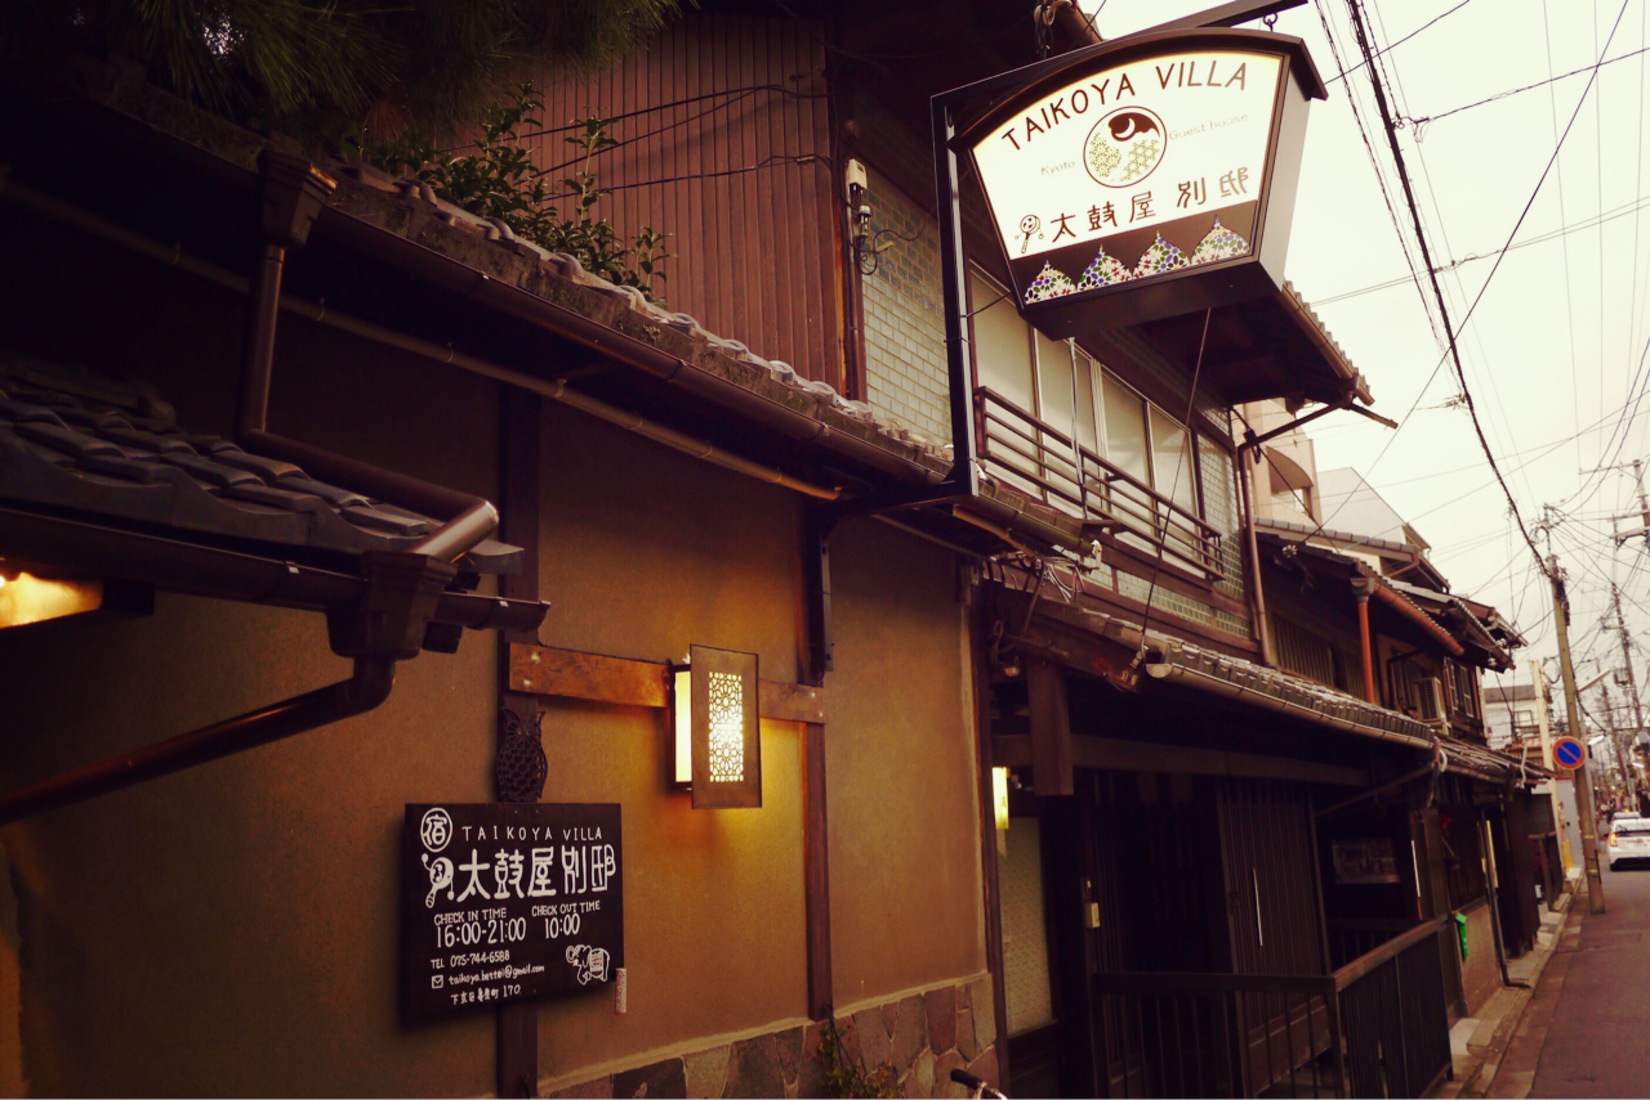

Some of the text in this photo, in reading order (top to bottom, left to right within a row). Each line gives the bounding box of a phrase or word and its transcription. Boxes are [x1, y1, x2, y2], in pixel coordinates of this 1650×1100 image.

[1001, 60, 1246, 150] TAIKOYA VILLA
[1169, 113, 1249, 141] Guest house
[1040, 160, 1075, 175] Kyoto
[423, 812, 449, 847] 宿
[461, 825, 602, 842] TAIKOYA VILLA
[434, 907, 507, 926] CHECK IN TIME
[531, 900, 601, 917] CHECK OUT TIME
[436, 917, 527, 949] 16:00-21:00
[544, 912, 581, 939] 10:00
[430, 949, 511, 970] TEL 075-744-6588
[503, 984, 521, 998] 170
